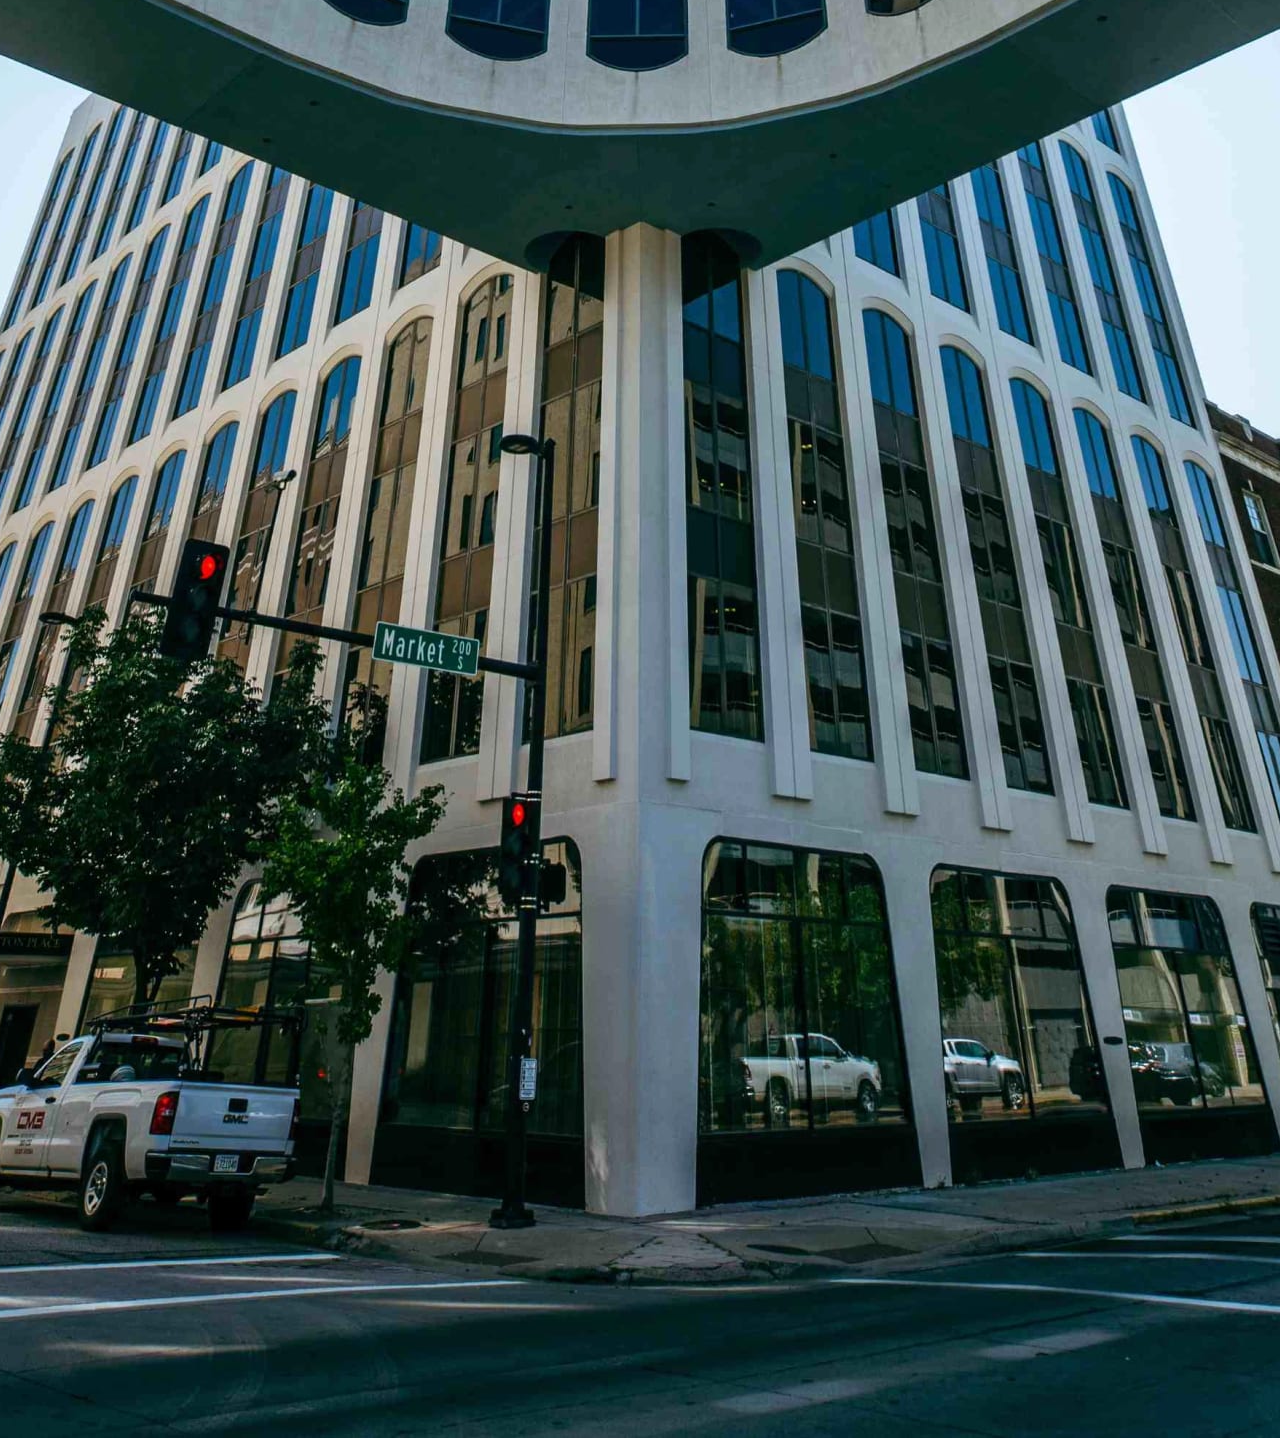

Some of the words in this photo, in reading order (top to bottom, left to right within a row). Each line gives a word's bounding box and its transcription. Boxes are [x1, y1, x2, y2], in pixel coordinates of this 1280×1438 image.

[381, 628, 445, 665] Market
[452, 639, 472, 656] 200
[457, 656, 463, 670] S
